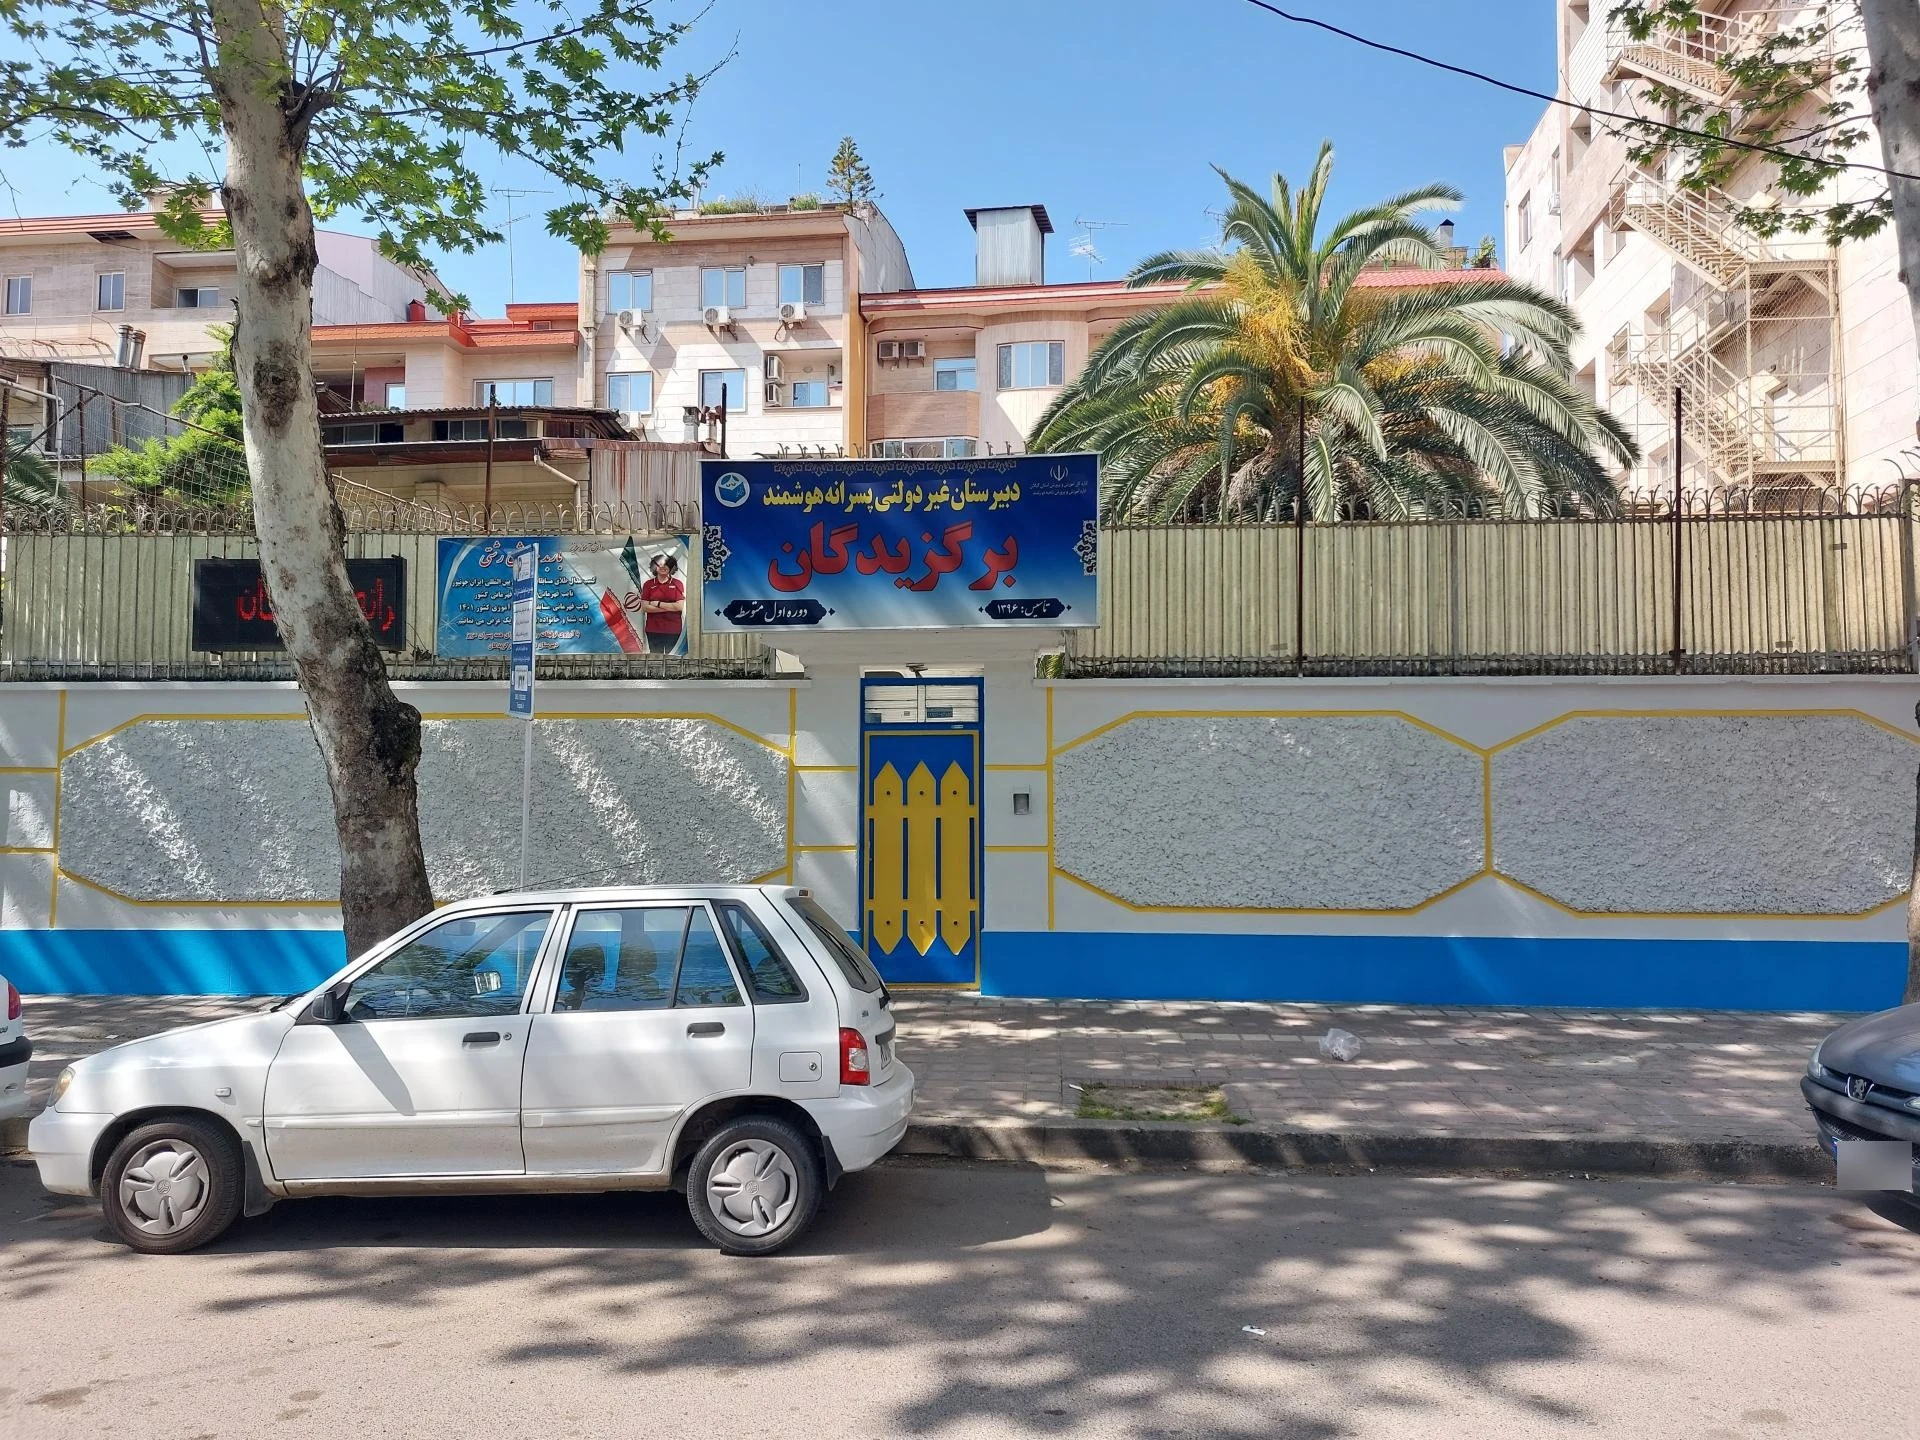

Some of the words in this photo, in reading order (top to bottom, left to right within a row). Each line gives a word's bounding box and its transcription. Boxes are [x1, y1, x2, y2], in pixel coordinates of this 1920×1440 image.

[763, 484, 824, 513] هوشمند
[825, 480, 873, 514] پسرانه
[875, 480, 922, 513] دولتی
[923, 480, 950, 512] غیر
[952, 480, 1021, 512] دبیرستان
[767, 520, 1019, 592] برگزیدگان
[763, 601, 786, 623] اول
[786, 607, 808, 619] دوره
[996, 603, 1019, 615] ۱۳۹۶
